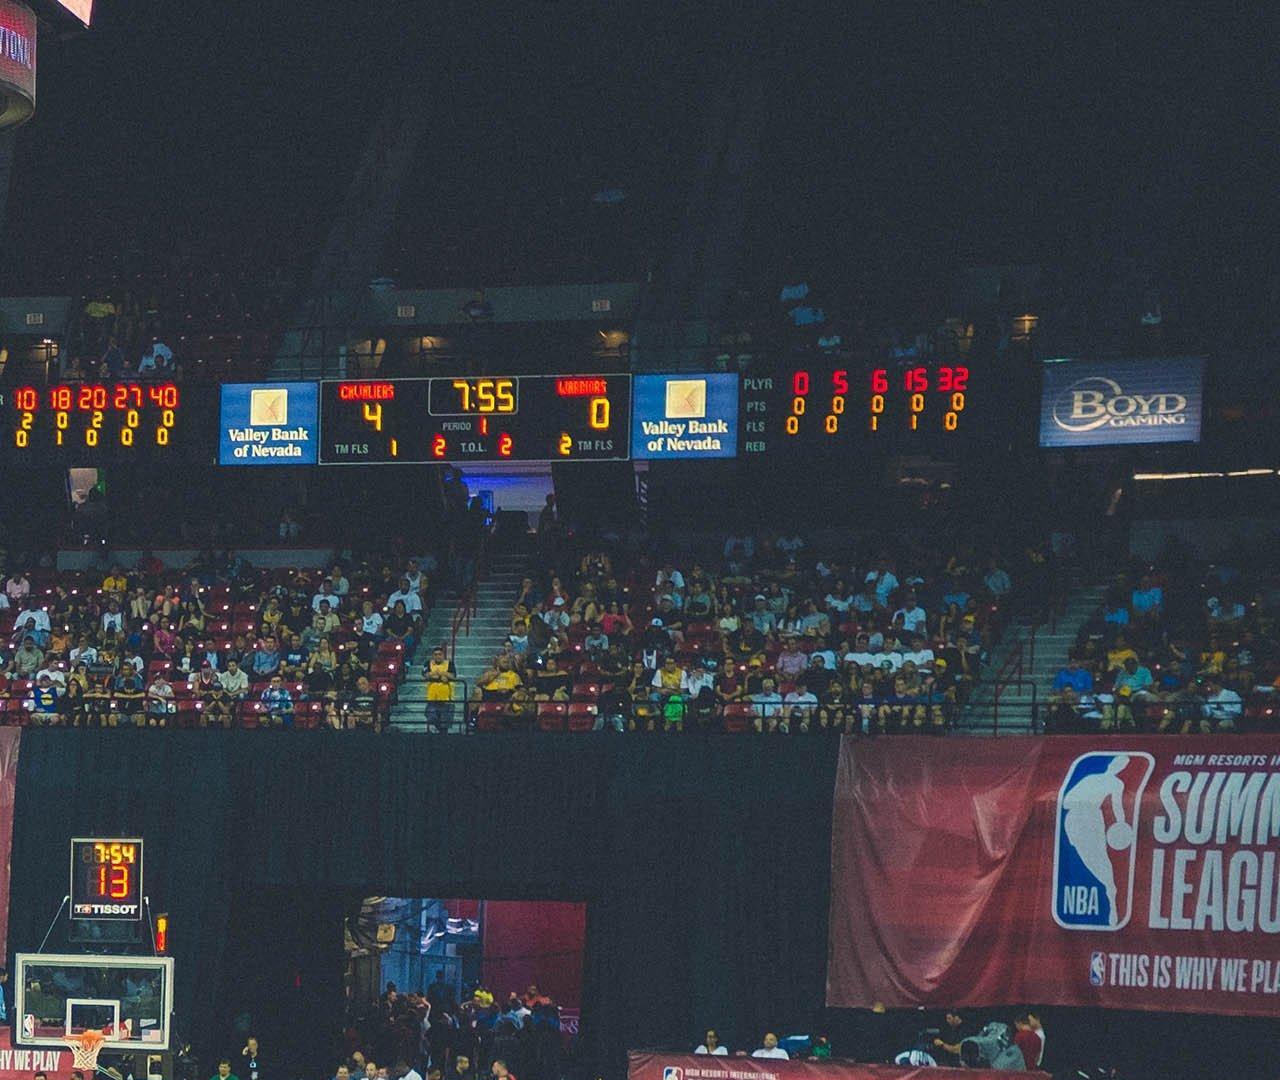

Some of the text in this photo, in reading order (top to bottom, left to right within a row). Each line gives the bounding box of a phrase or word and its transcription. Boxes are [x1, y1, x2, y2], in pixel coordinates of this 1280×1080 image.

[743, 366, 969, 395] PLYR 0 5 6 15 32
[16, 390, 36, 410] 10
[52, 389, 71, 410] 18
[79, 388, 106, 410] 20
[115, 388, 141, 409] 27
[151, 386, 177, 408] 40
[452, 379, 515, 412] 7:55
[746, 393, 964, 415] PTS 0 0 0 0 0
[1070, 390, 1187, 420] BOYD
[21, 412, 33, 429] 2
[57, 412, 68, 429] 0
[92, 411, 103, 428] 2
[128, 410, 139, 428] 0
[163, 409, 174, 427] 0
[362, 403, 382, 432] 4
[591, 397, 610, 430] 0
[746, 422, 766, 432] FLS
[786, 416, 799, 435] 0
[945, 411, 958, 431] 0
[1109, 414, 1186, 428] GAMING
[228, 427, 309, 442] Valley Bank
[442, 417, 488, 435] PERIOD 1
[642, 419, 728, 436] Valley Bank
[16, 429, 27, 447] 0
[86, 428, 97, 447] 0
[121, 428, 133, 446] 0
[156, 427, 168, 446] 0
[351, 443, 369, 454] FLS
[391, 438, 398, 456] 1
[435, 438, 446, 456] 2
[501, 436, 512, 455] 2
[560, 433, 572, 455] 2
[594, 439, 614, 451] FLS
[647, 437, 722, 452] of Nevada
[234, 443, 302, 457] of Nevada
[1173, 754, 1206, 766] MGM
[1208, 755, 1268, 767] RESORTS
[94, 844, 136, 865] 7:54
[100, 866, 129, 898] 13
[91, 904, 138, 914] TISSOT
[1063, 884, 1099, 917] NBA
[1109, 952, 1150, 988] THIS
[1152, 954, 1173, 989] IS
[1175, 955, 1218, 991] WHY
[1220, 957, 1249, 993] WE
[13, 1050, 32, 1071] WE
[32, 1050, 61, 1072] PLAY
